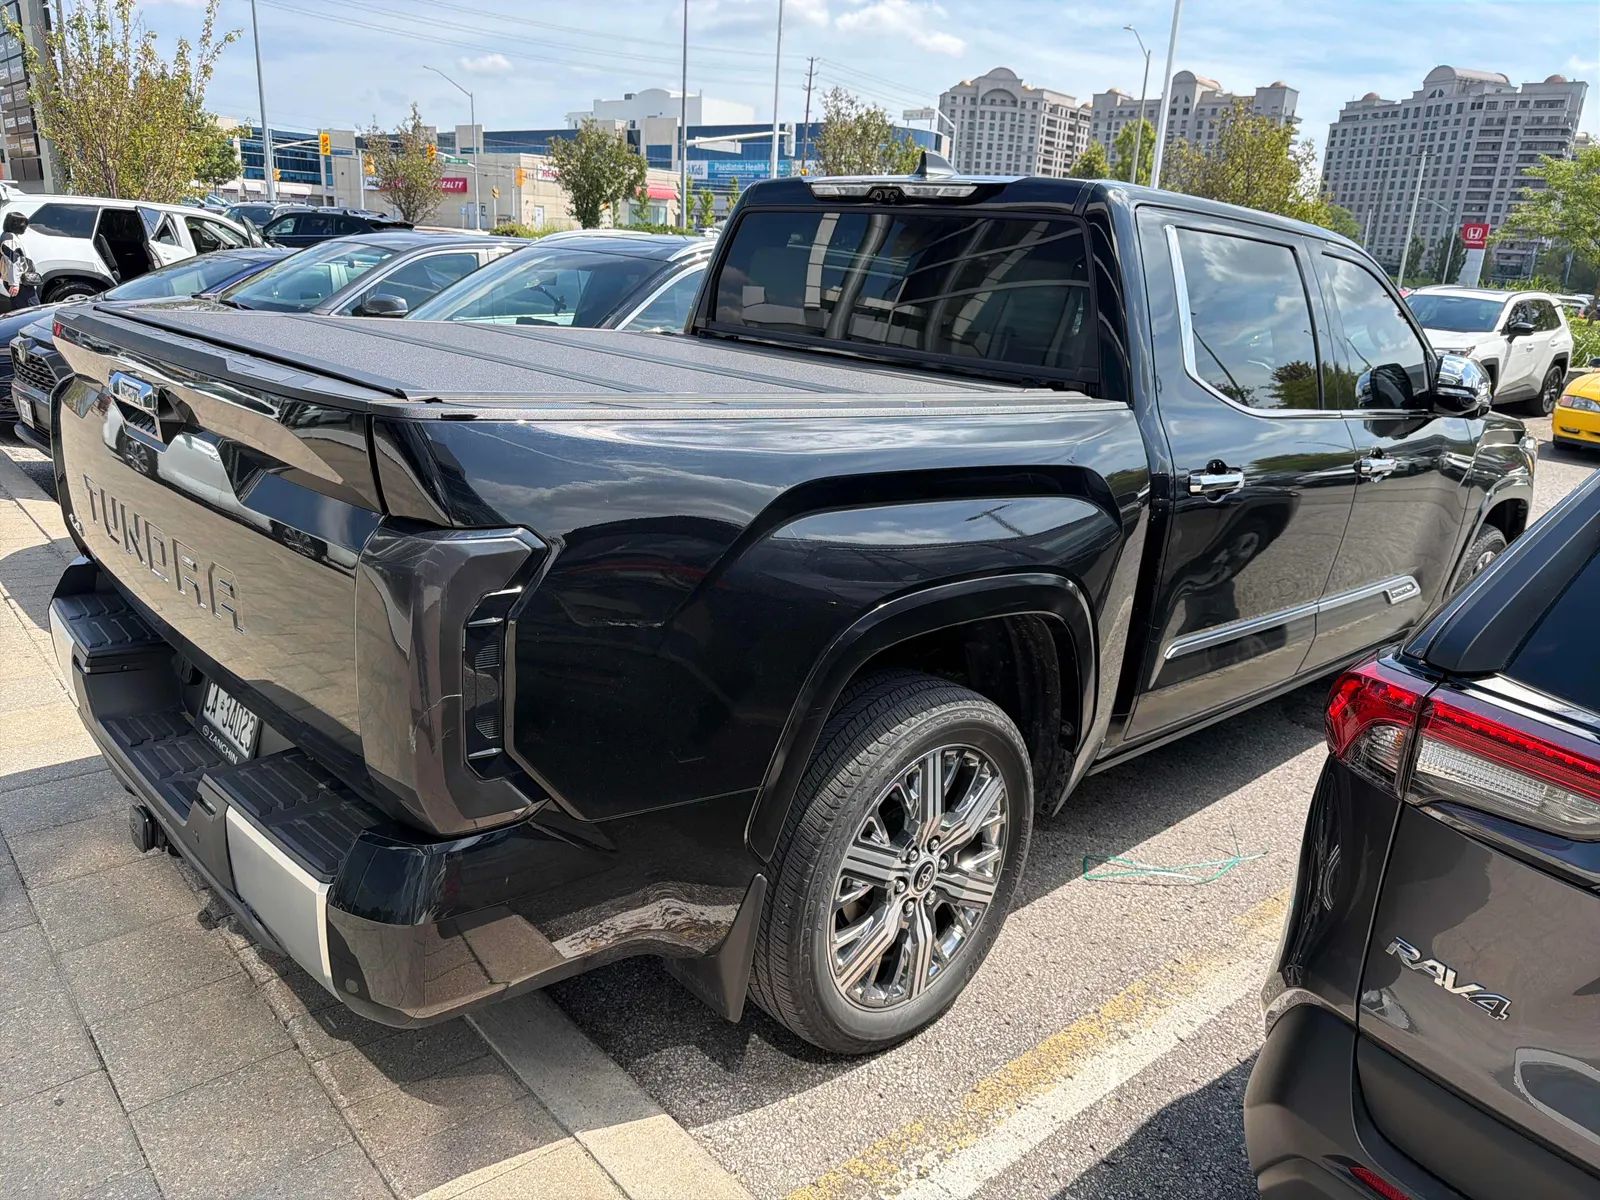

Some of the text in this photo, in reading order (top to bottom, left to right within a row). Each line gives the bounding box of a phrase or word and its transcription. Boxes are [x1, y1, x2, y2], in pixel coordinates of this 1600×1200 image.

[714, 162, 744, 171] Paediatric
[745, 162, 765, 171] Health
[439, 180, 464, 189] EALTY
[82, 473, 247, 636] TUNDRA
[208, 731, 238, 765] ZANCHIN
[1385, 936, 1512, 1021] RAV4
